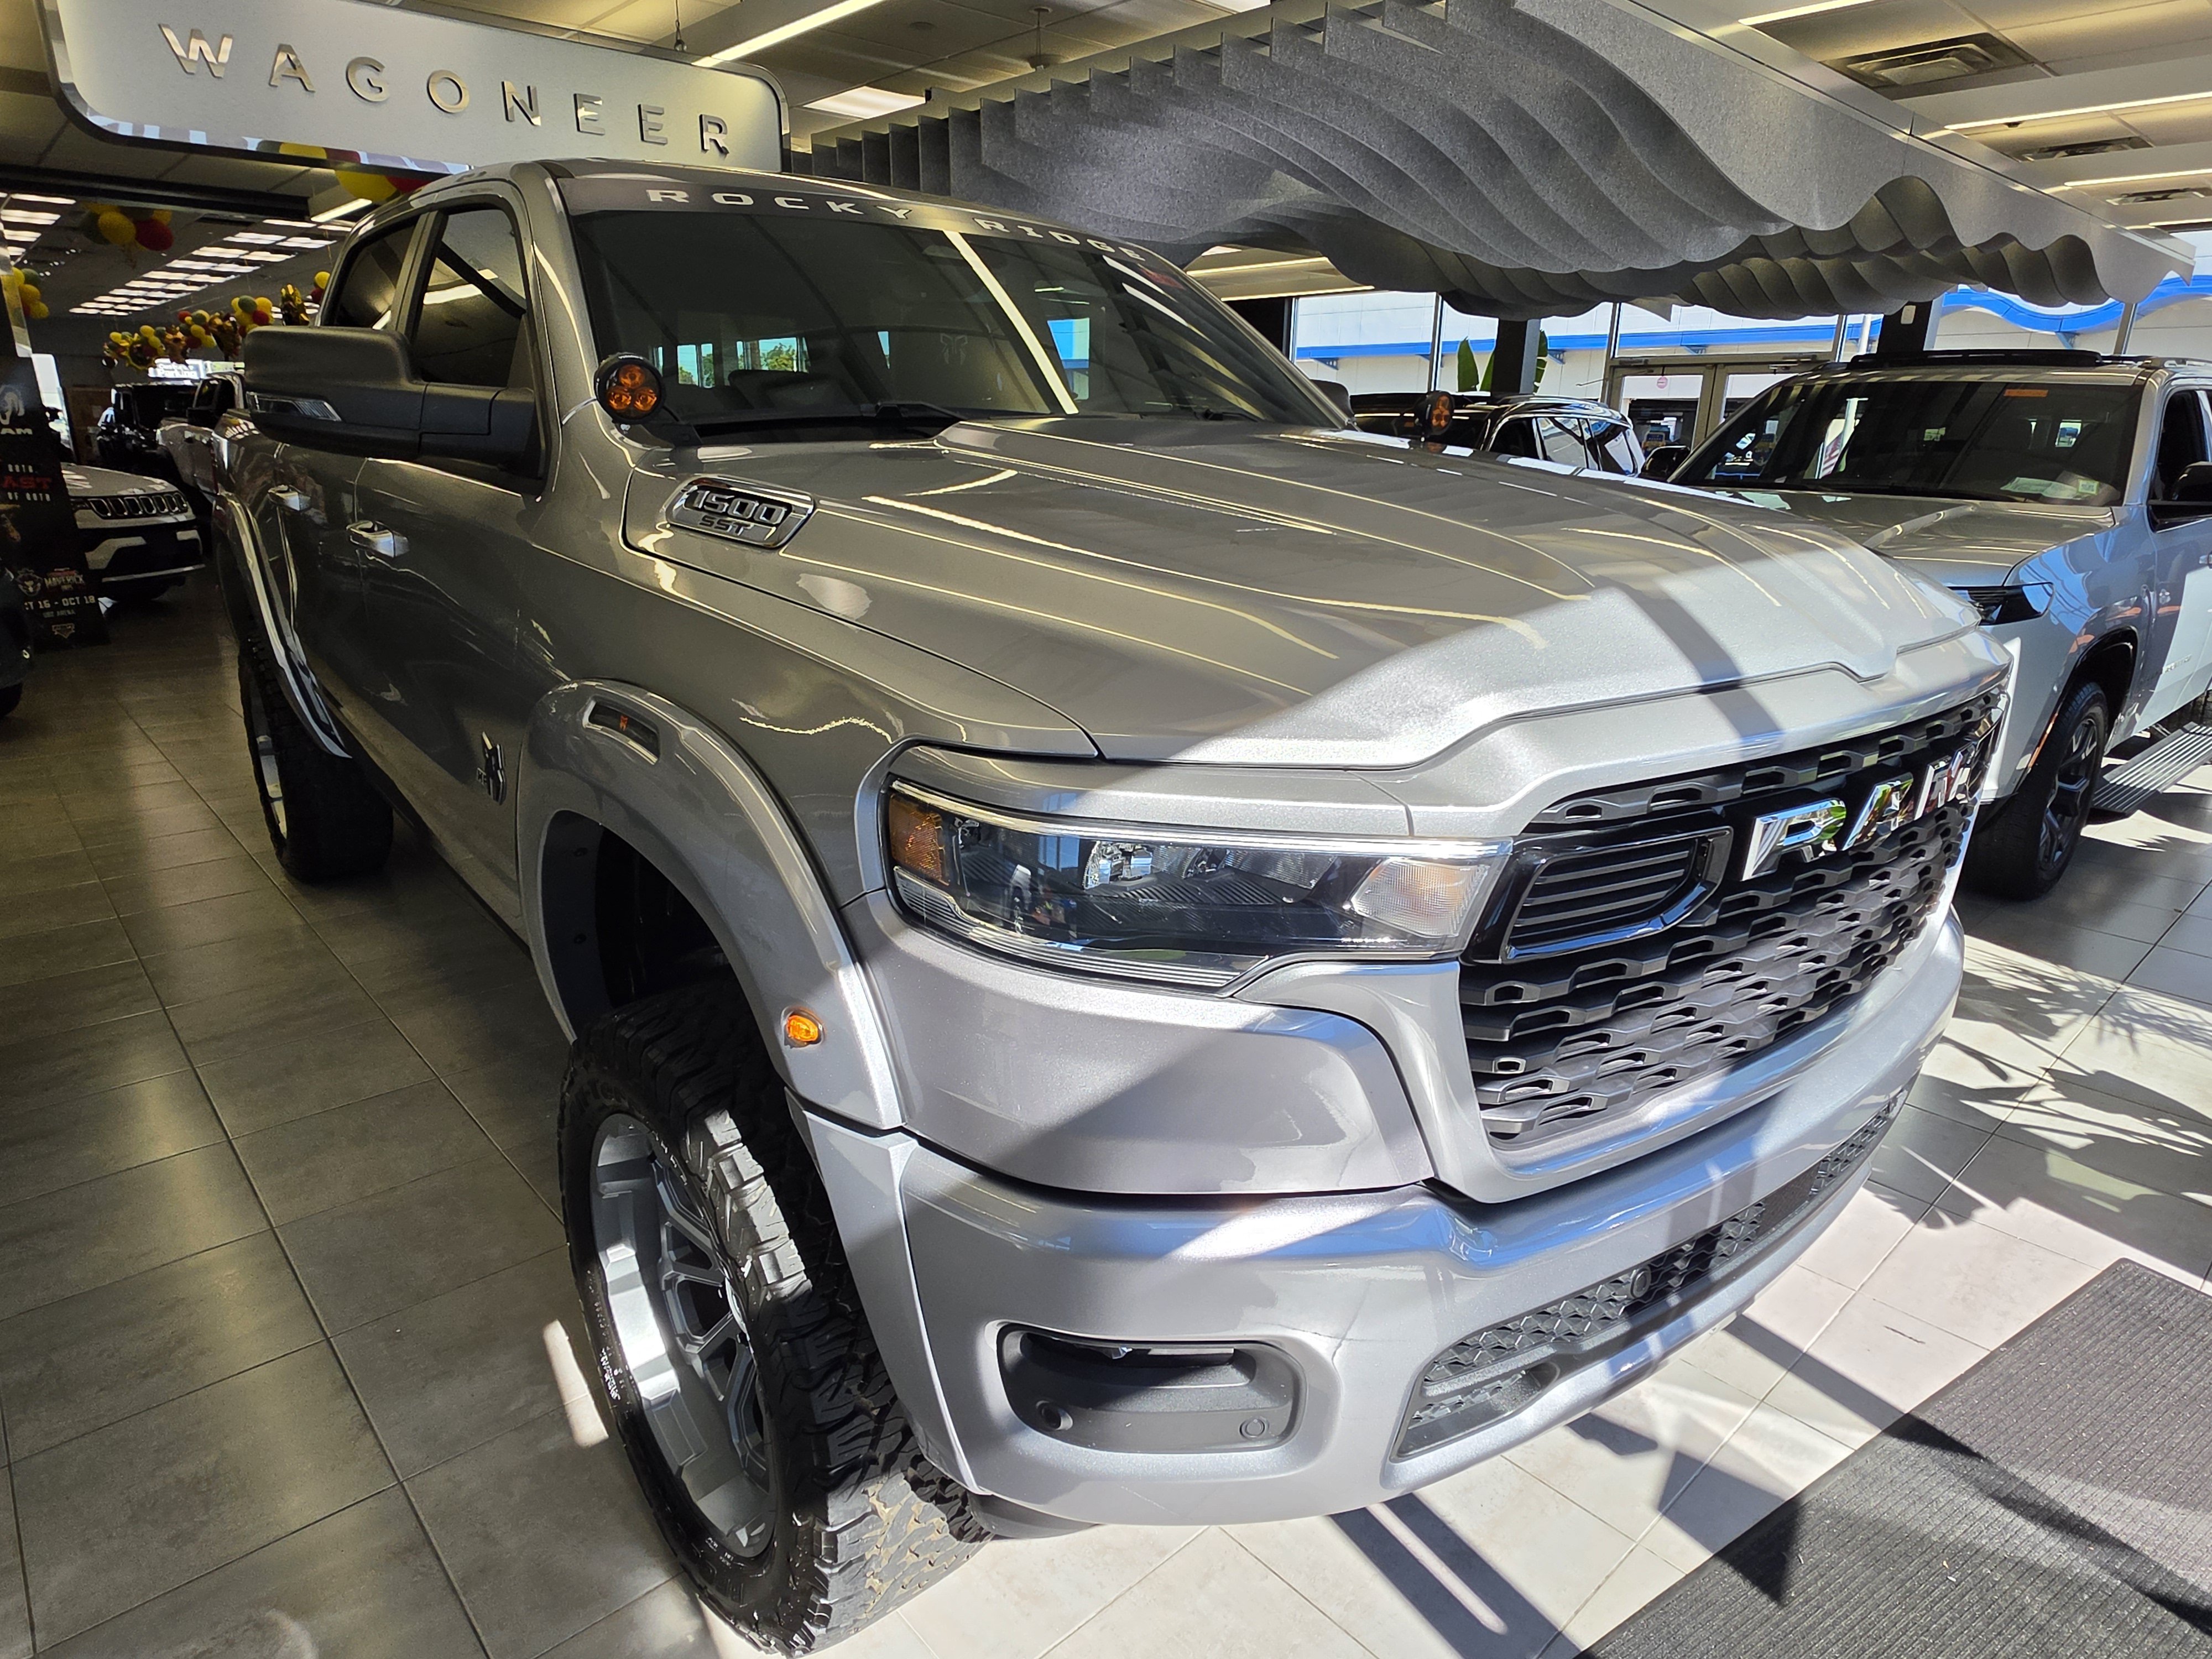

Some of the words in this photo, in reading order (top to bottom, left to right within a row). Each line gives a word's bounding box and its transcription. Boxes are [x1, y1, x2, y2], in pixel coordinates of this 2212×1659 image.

[158, 23, 730, 155] WAGONEER
[646, 189, 913, 220] ROCKY
[972, 218, 1146, 262] RIDGE
[692, 490, 787, 525] 1500
[699, 515, 755, 536] SST
[62, 596, 81, 607] OCT
[84, 595, 96, 604] 18
[1740, 742, 1976, 882] RAM
